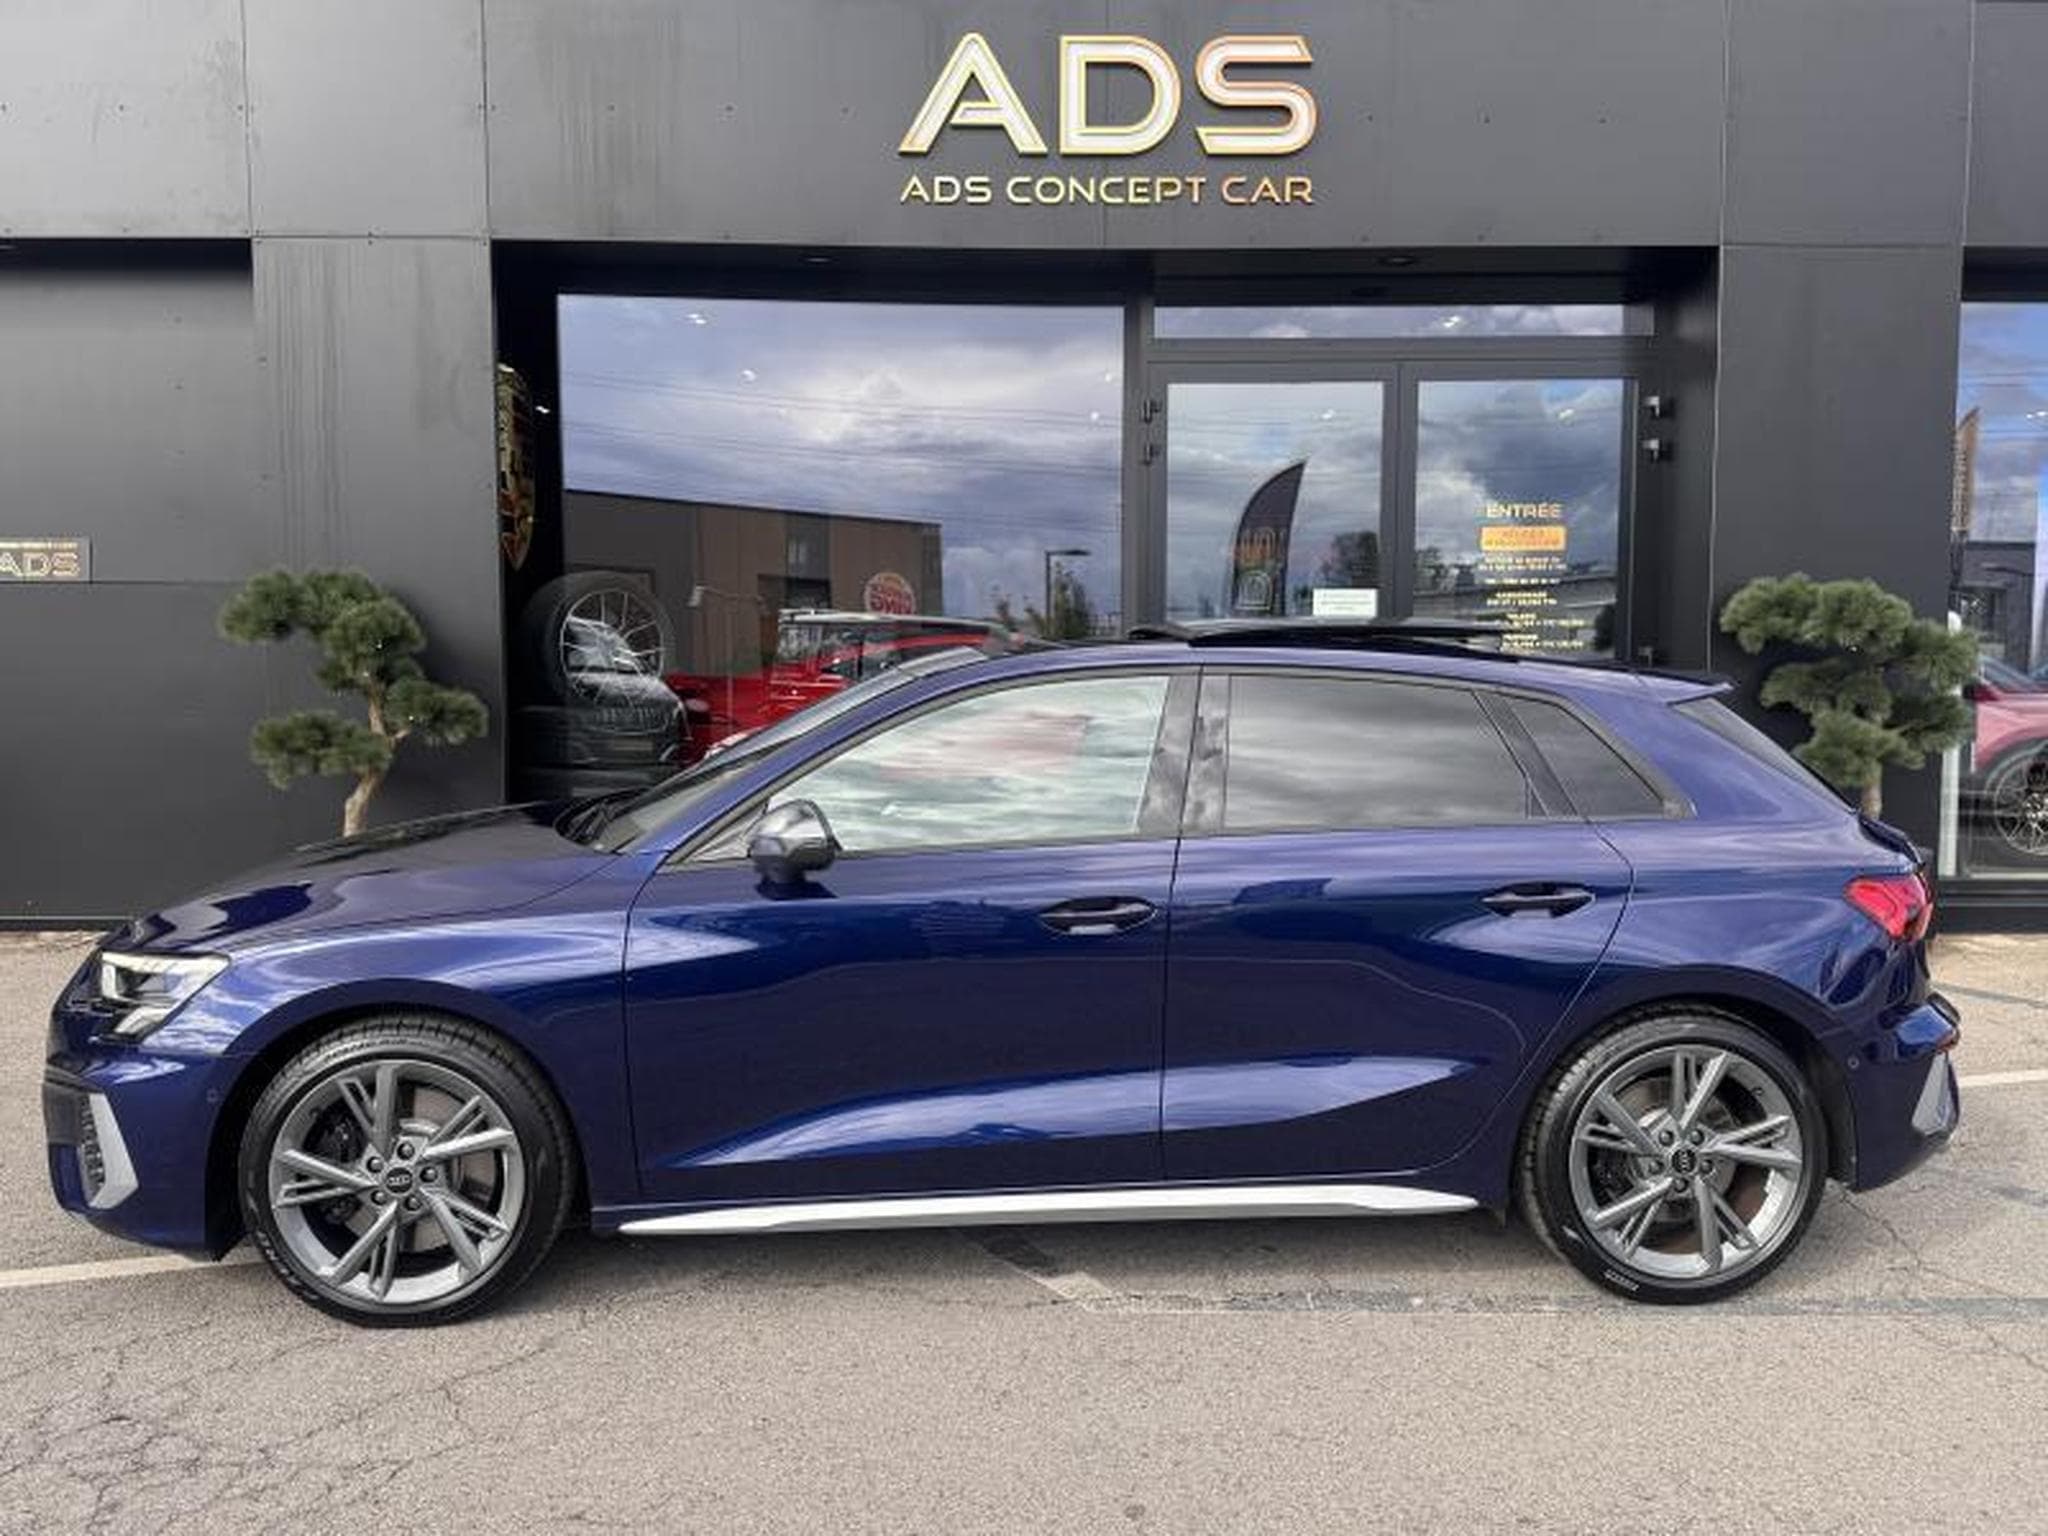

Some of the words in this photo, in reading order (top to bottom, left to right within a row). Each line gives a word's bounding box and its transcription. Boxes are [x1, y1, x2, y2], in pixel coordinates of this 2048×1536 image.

[898, 32, 1317, 154] ADS
[900, 175, 992, 203] ADS
[1006, 175, 1207, 203] CONCEPT
[1222, 175, 1314, 203] CAR
